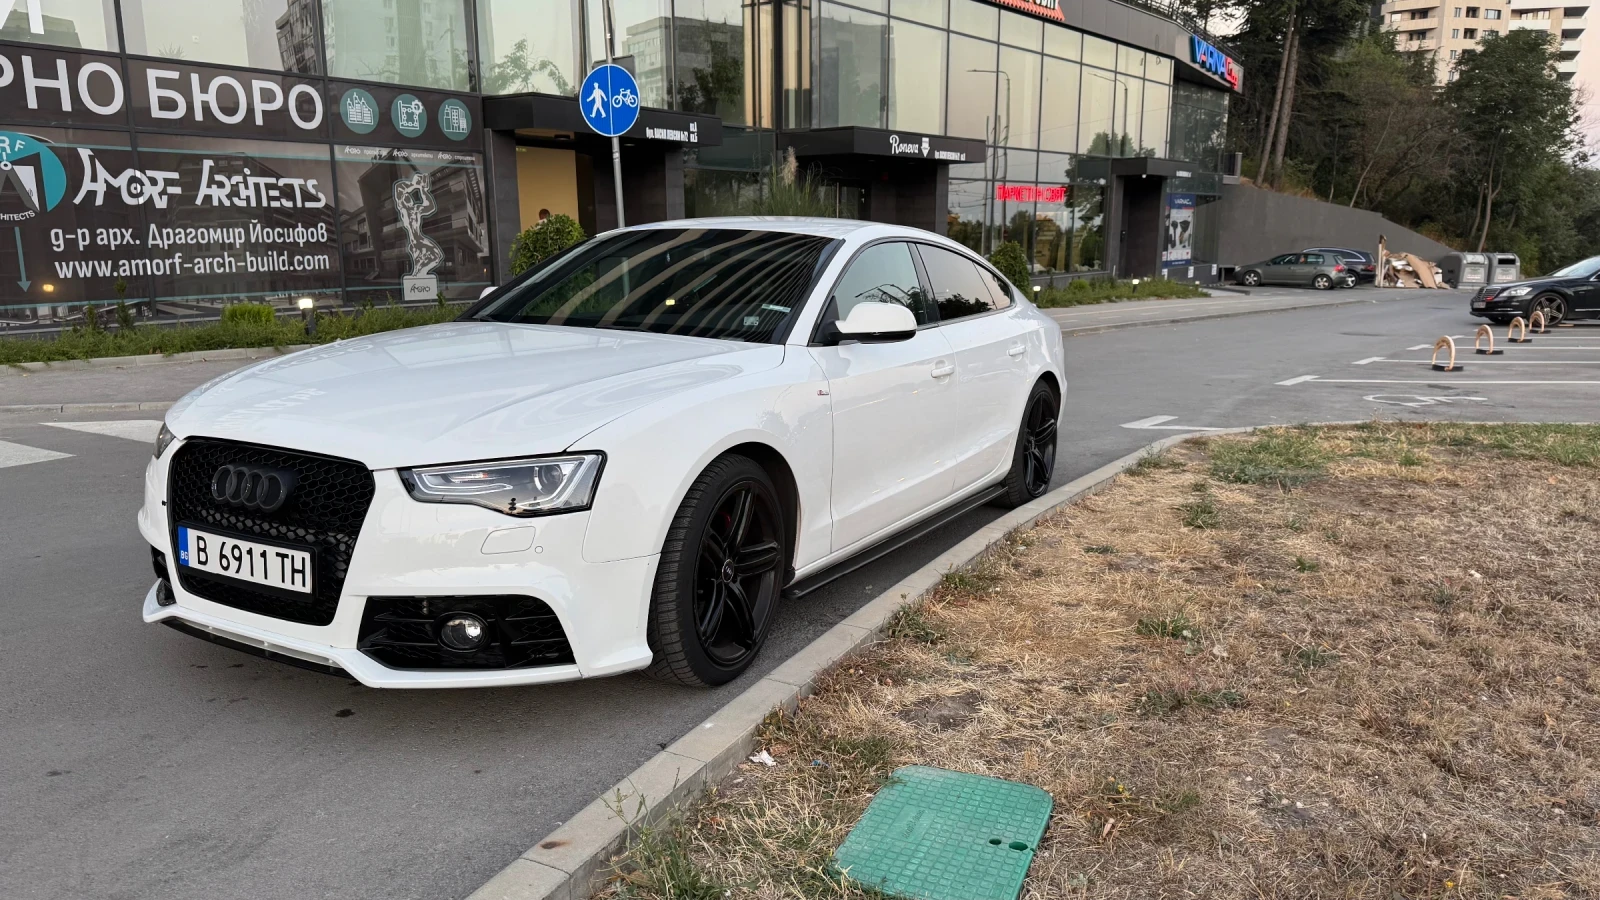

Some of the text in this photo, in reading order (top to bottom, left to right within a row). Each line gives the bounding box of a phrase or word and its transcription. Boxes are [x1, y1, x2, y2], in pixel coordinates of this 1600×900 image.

[146, 68, 323, 130] БЮРО
[889, 134, 919, 154] Roneva
[1045, 186, 1067, 202] СВЯТ
[0, 210, 35, 221] HITECTS
[96, 226, 141, 250] арх.
[148, 223, 245, 250] Драгомир
[249, 219, 328, 246] Йосифов
[54, 250, 330, 278] www.amorf-arch-build.com
[180, 550, 189, 560] BG
[196, 535, 307, 588] B 6911 TH
